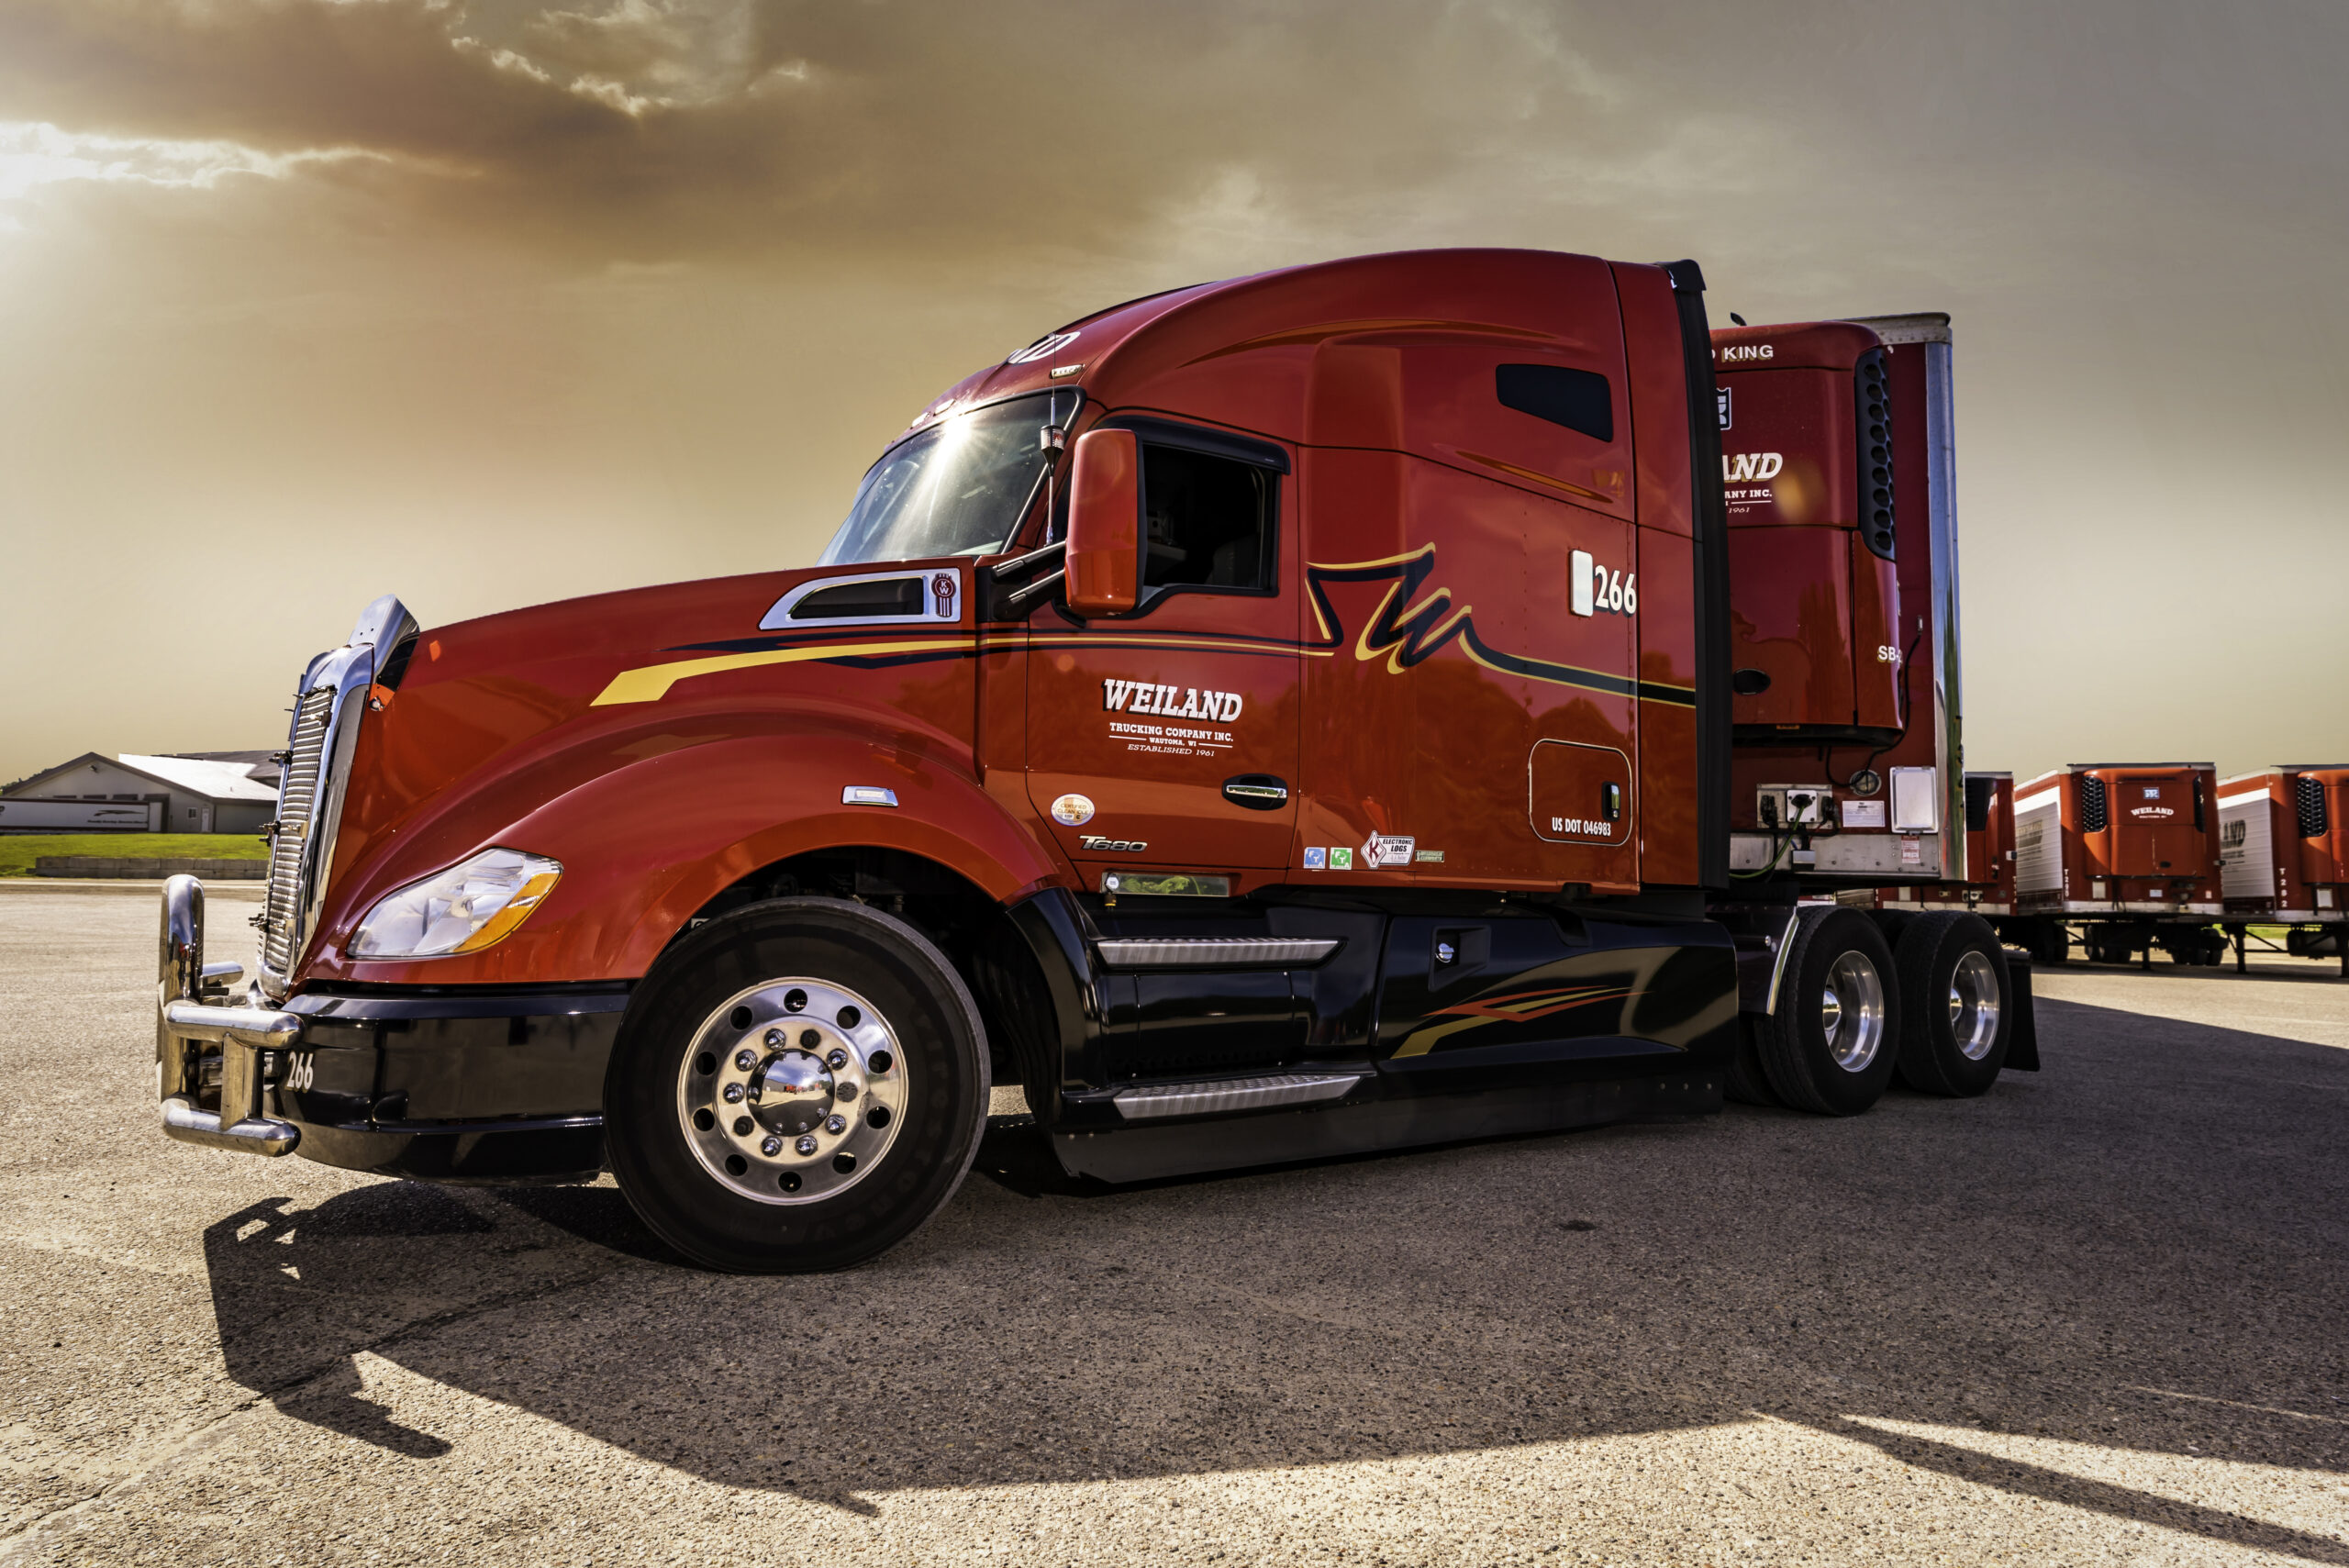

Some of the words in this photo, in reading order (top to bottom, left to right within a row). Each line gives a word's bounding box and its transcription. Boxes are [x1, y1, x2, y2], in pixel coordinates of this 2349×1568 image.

[1722, 344, 1774, 361] KING
[1749, 489, 1773, 498] INC.
[1594, 564, 1637, 616] 266
[1102, 678, 1243, 723] WEILAND
[1109, 722, 1163, 736] TRUCKING
[1165, 727, 1212, 740] COMPANY
[1214, 732, 1234, 742] INC.
[1127, 744, 1192, 755] ESTABLISHED
[1149, 737, 1186, 746] WAUTOMA,
[2131, 806, 2175, 816] WEILAND
[1552, 817, 1563, 832] US
[1564, 817, 1582, 834] DOT
[1583, 819, 1611, 836] 046983
[1079, 835, 1148, 851] T680
[1390, 844, 1408, 852] LOGS
[286, 1050, 314, 1090] 266
